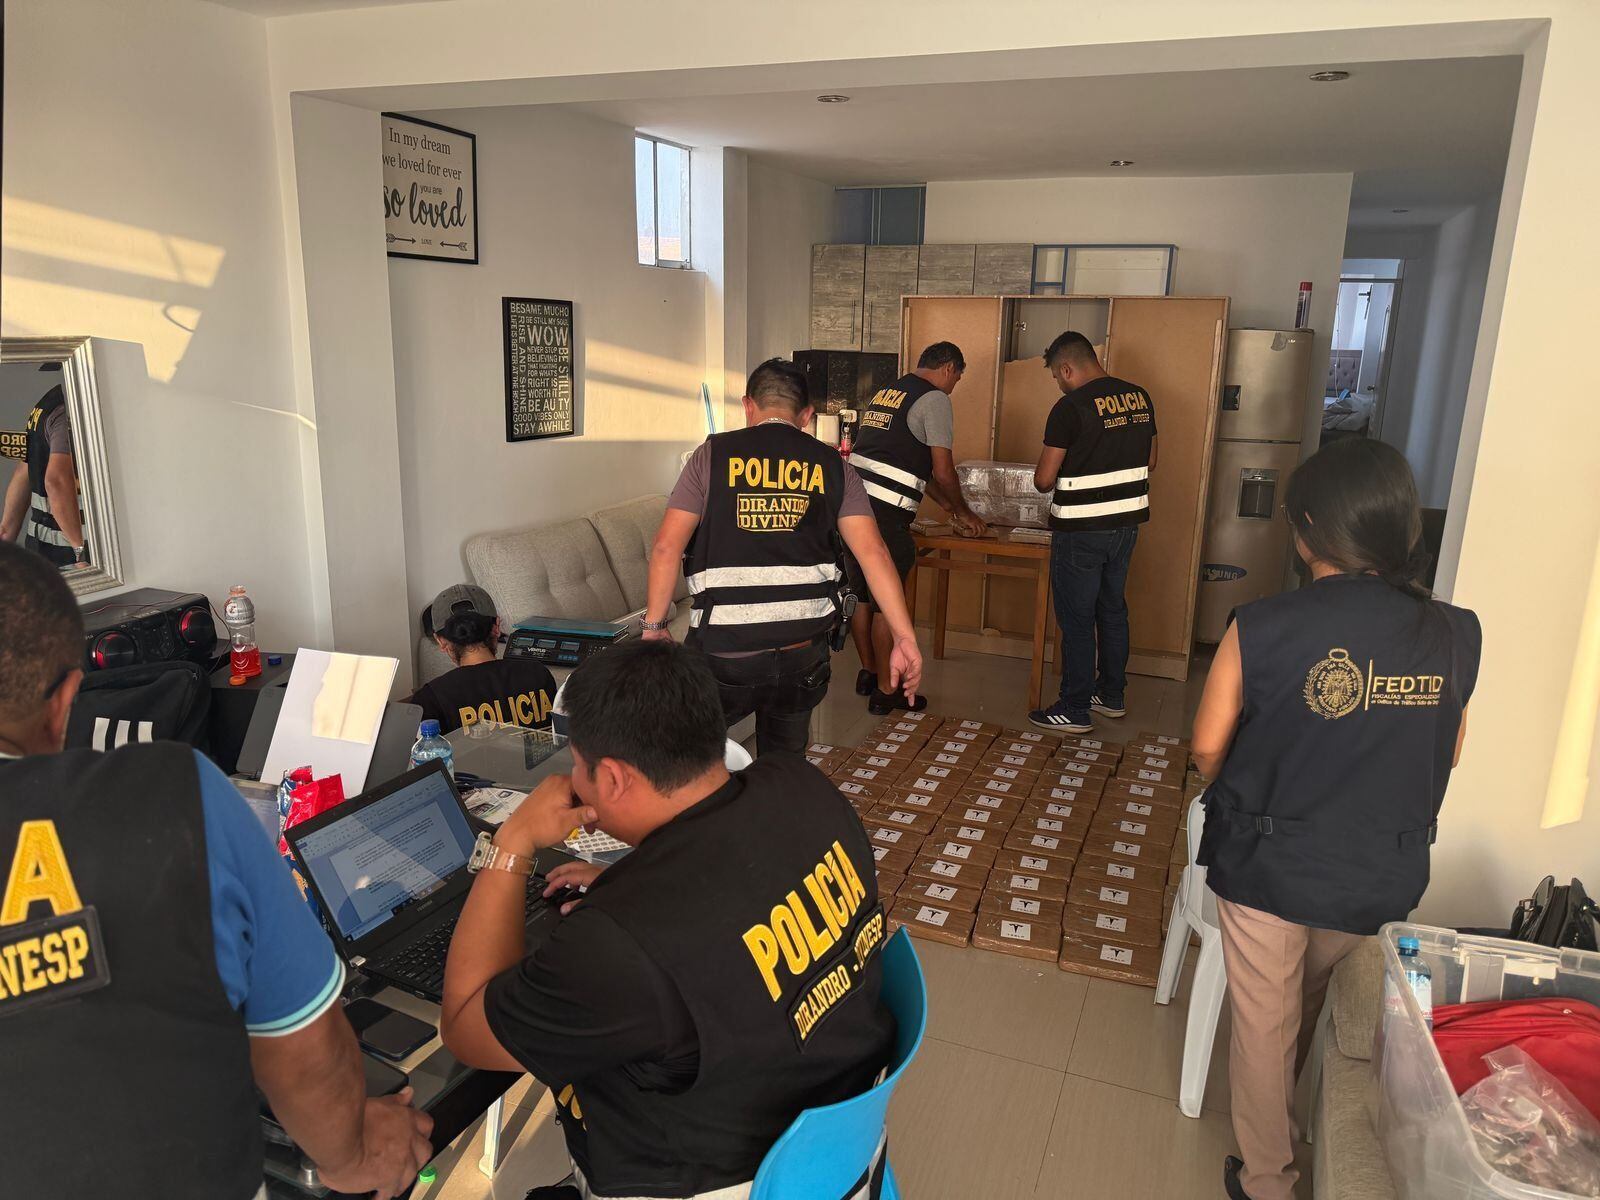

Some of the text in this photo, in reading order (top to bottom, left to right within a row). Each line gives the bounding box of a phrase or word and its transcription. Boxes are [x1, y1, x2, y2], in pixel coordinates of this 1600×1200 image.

[390, 127, 451, 155] In my dream
[382, 154, 462, 180] we loved for ever
[420, 184, 442, 195] you are
[410, 182, 466, 229] loved
[510, 302, 569, 316] BESAME MUCHO
[527, 325, 568, 346] WOW
[528, 354, 557, 362] BELIEVING
[559, 348, 569, 397] BE STILL
[528, 378, 558, 387] RIGHT IS
[528, 389, 557, 398] WORTH IT
[513, 411, 569, 422] GOOD VIBES ONLY
[513, 420, 570, 434] STAY AWHILE
[1372, 676, 1444, 693] FEDTID
[0, 819, 83, 926] A
